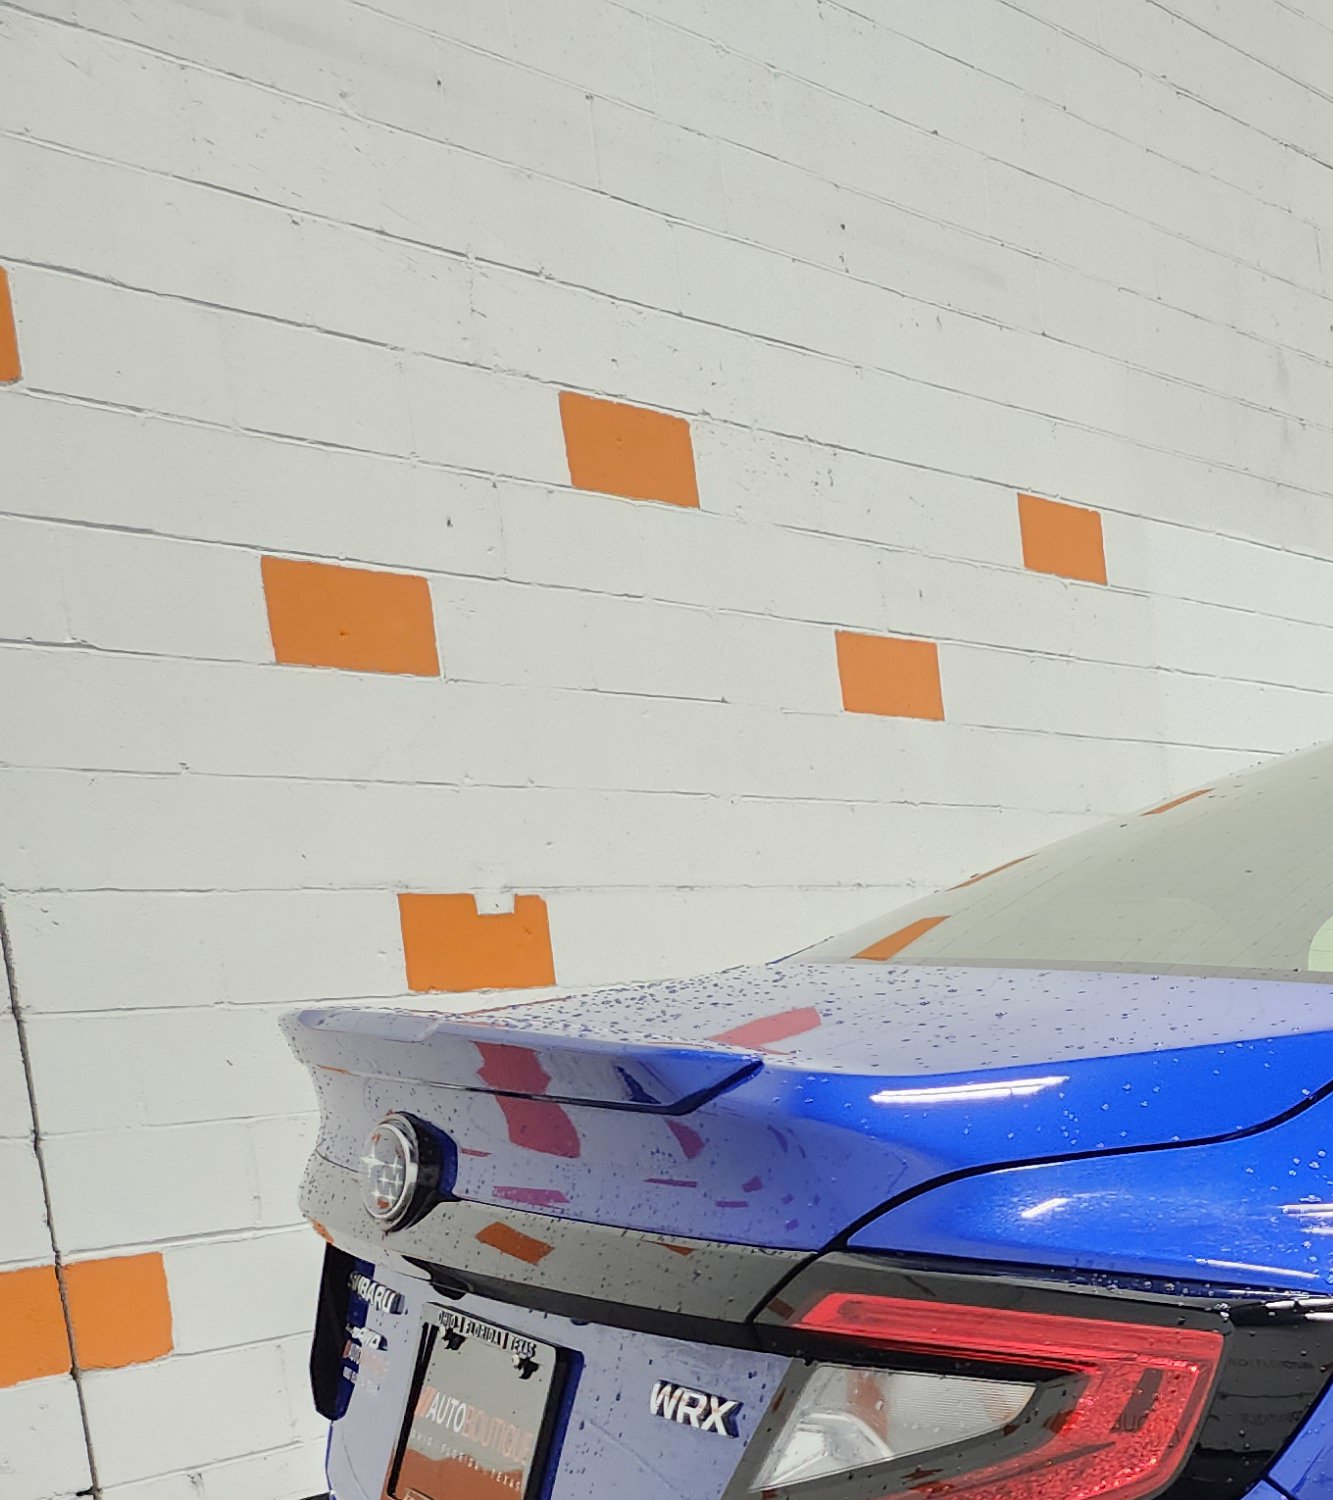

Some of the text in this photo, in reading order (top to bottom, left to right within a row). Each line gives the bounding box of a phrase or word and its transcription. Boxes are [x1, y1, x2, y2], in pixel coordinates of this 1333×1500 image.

[347, 1271, 398, 1314] SUBARU
[466, 1318, 501, 1345] FLORIDA
[511, 1336, 537, 1358] TEXAS
[650, 1383, 738, 1436] WRX
